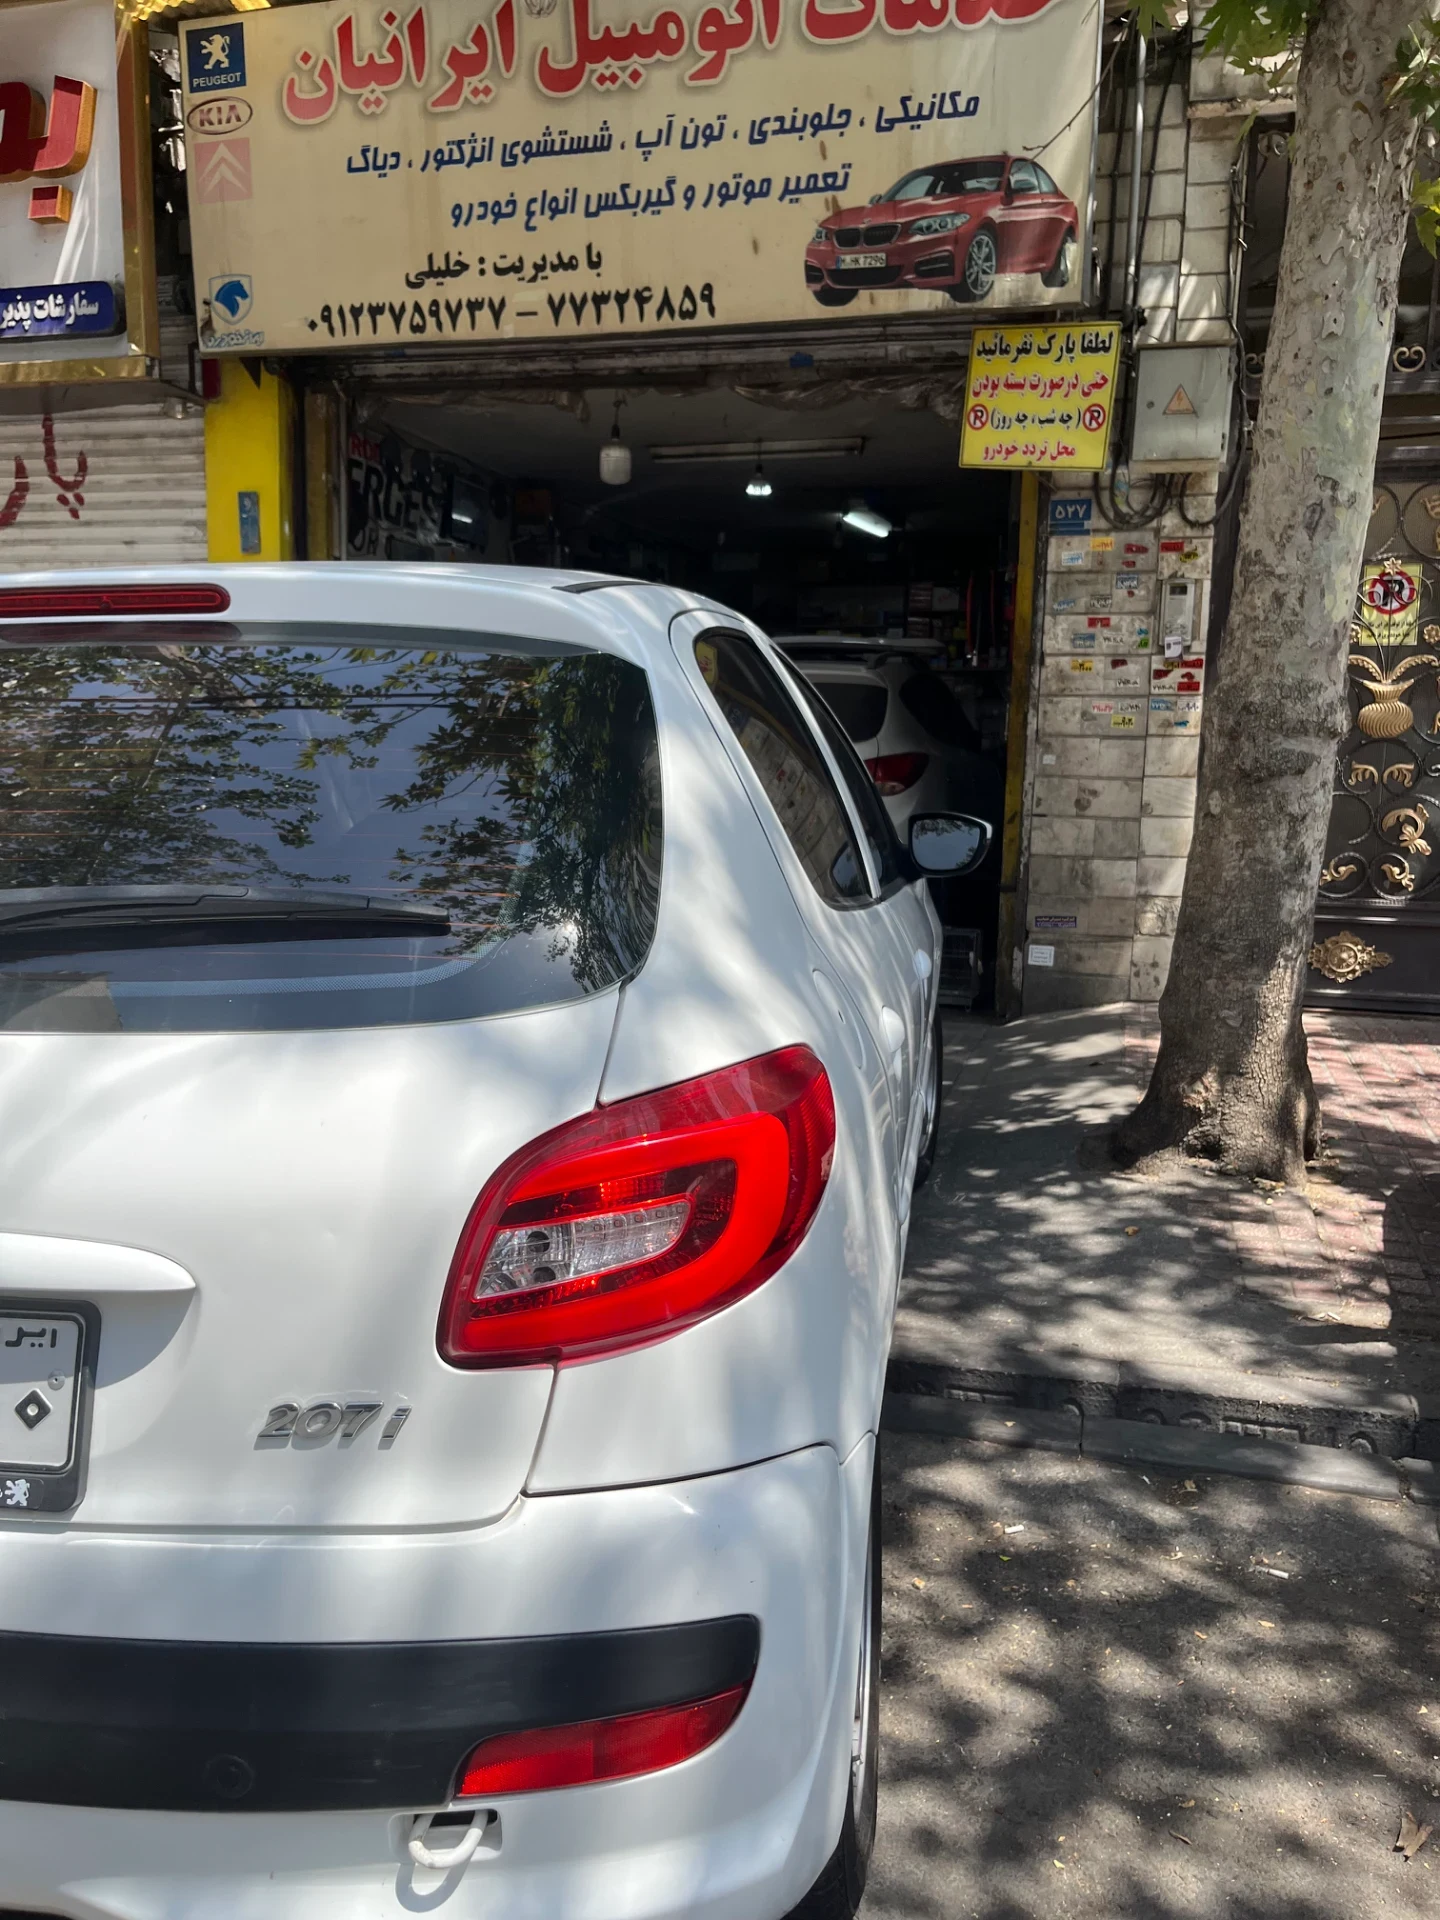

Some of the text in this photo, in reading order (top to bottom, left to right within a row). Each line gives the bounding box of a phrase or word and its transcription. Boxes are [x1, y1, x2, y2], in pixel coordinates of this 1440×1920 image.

[283, 0, 516, 122] ایرانیان
[192, 72, 242, 88] PEUGEOT
[198, 105, 242, 127] KIA
[347, 145, 401, 178] دیاگ
[584, 175, 677, 218] گیربکس
[702, 172, 772, 208] موتور
[777, 162, 852, 204] تعمیر
[451, 192, 517, 228] خودرو
[524, 187, 578, 232] انواع
[405, 250, 470, 289] خلیلی
[493, 250, 579, 284] مدیریت
[585, 243, 603, 278] با
[0, 290, 99, 332] سفارشات پذیر
[307, 295, 506, 338] ۰۹۱۲۳۷۵۹۷۳۷
[548, 281, 716, 327] ۷۷۳۲۴۸۵۹
[1037, 332, 1076, 363] پارک
[1080, 331, 1113, 355] لطفا
[972, 374, 1000, 398] بودن
[1002, 372, 1027, 396] بسته
[1081, 371, 1109, 397] حتی
[983, 439, 1076, 461] محل تردد خودرو
